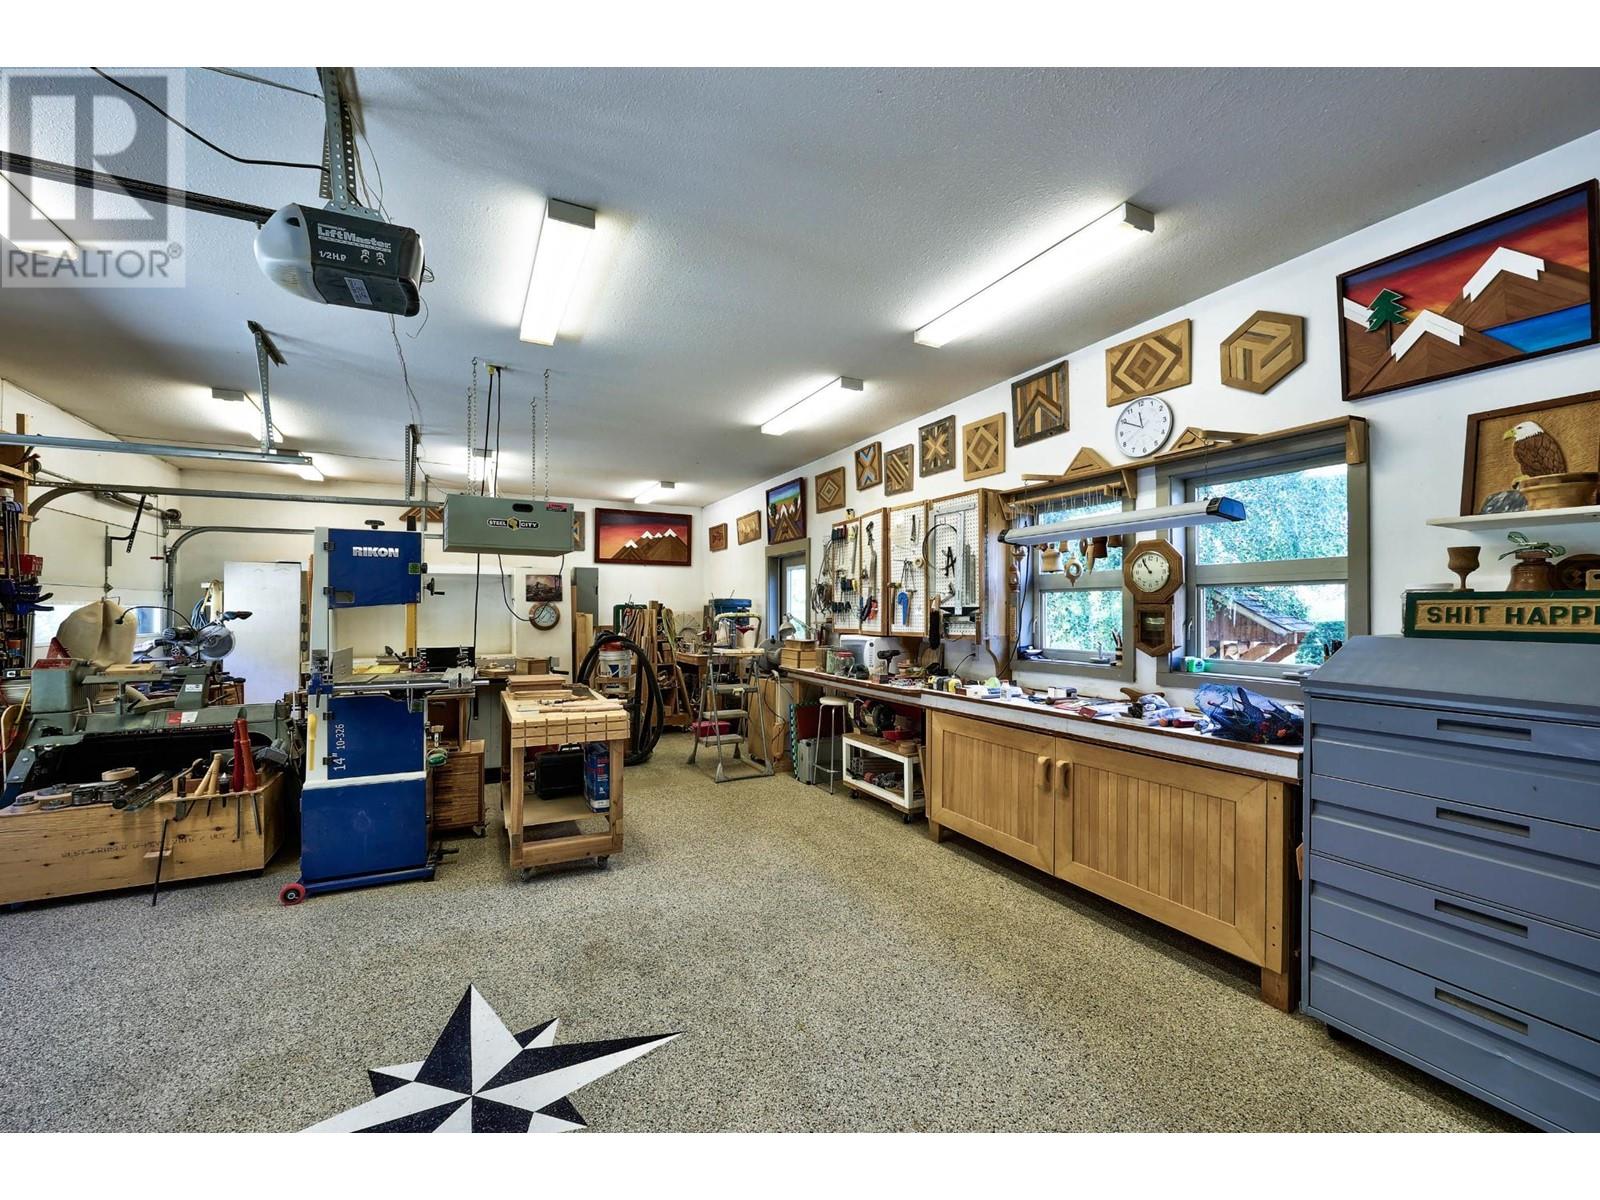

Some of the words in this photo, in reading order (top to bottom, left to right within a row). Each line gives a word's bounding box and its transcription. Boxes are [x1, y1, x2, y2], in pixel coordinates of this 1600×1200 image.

[317, 226, 391, 249] LiftMaster
[352, 546, 399, 558] RIKON
[1427, 606, 1491, 624] SHIT
[335, 723, 346, 750] 10-326
[332, 752, 346, 771] 14"
